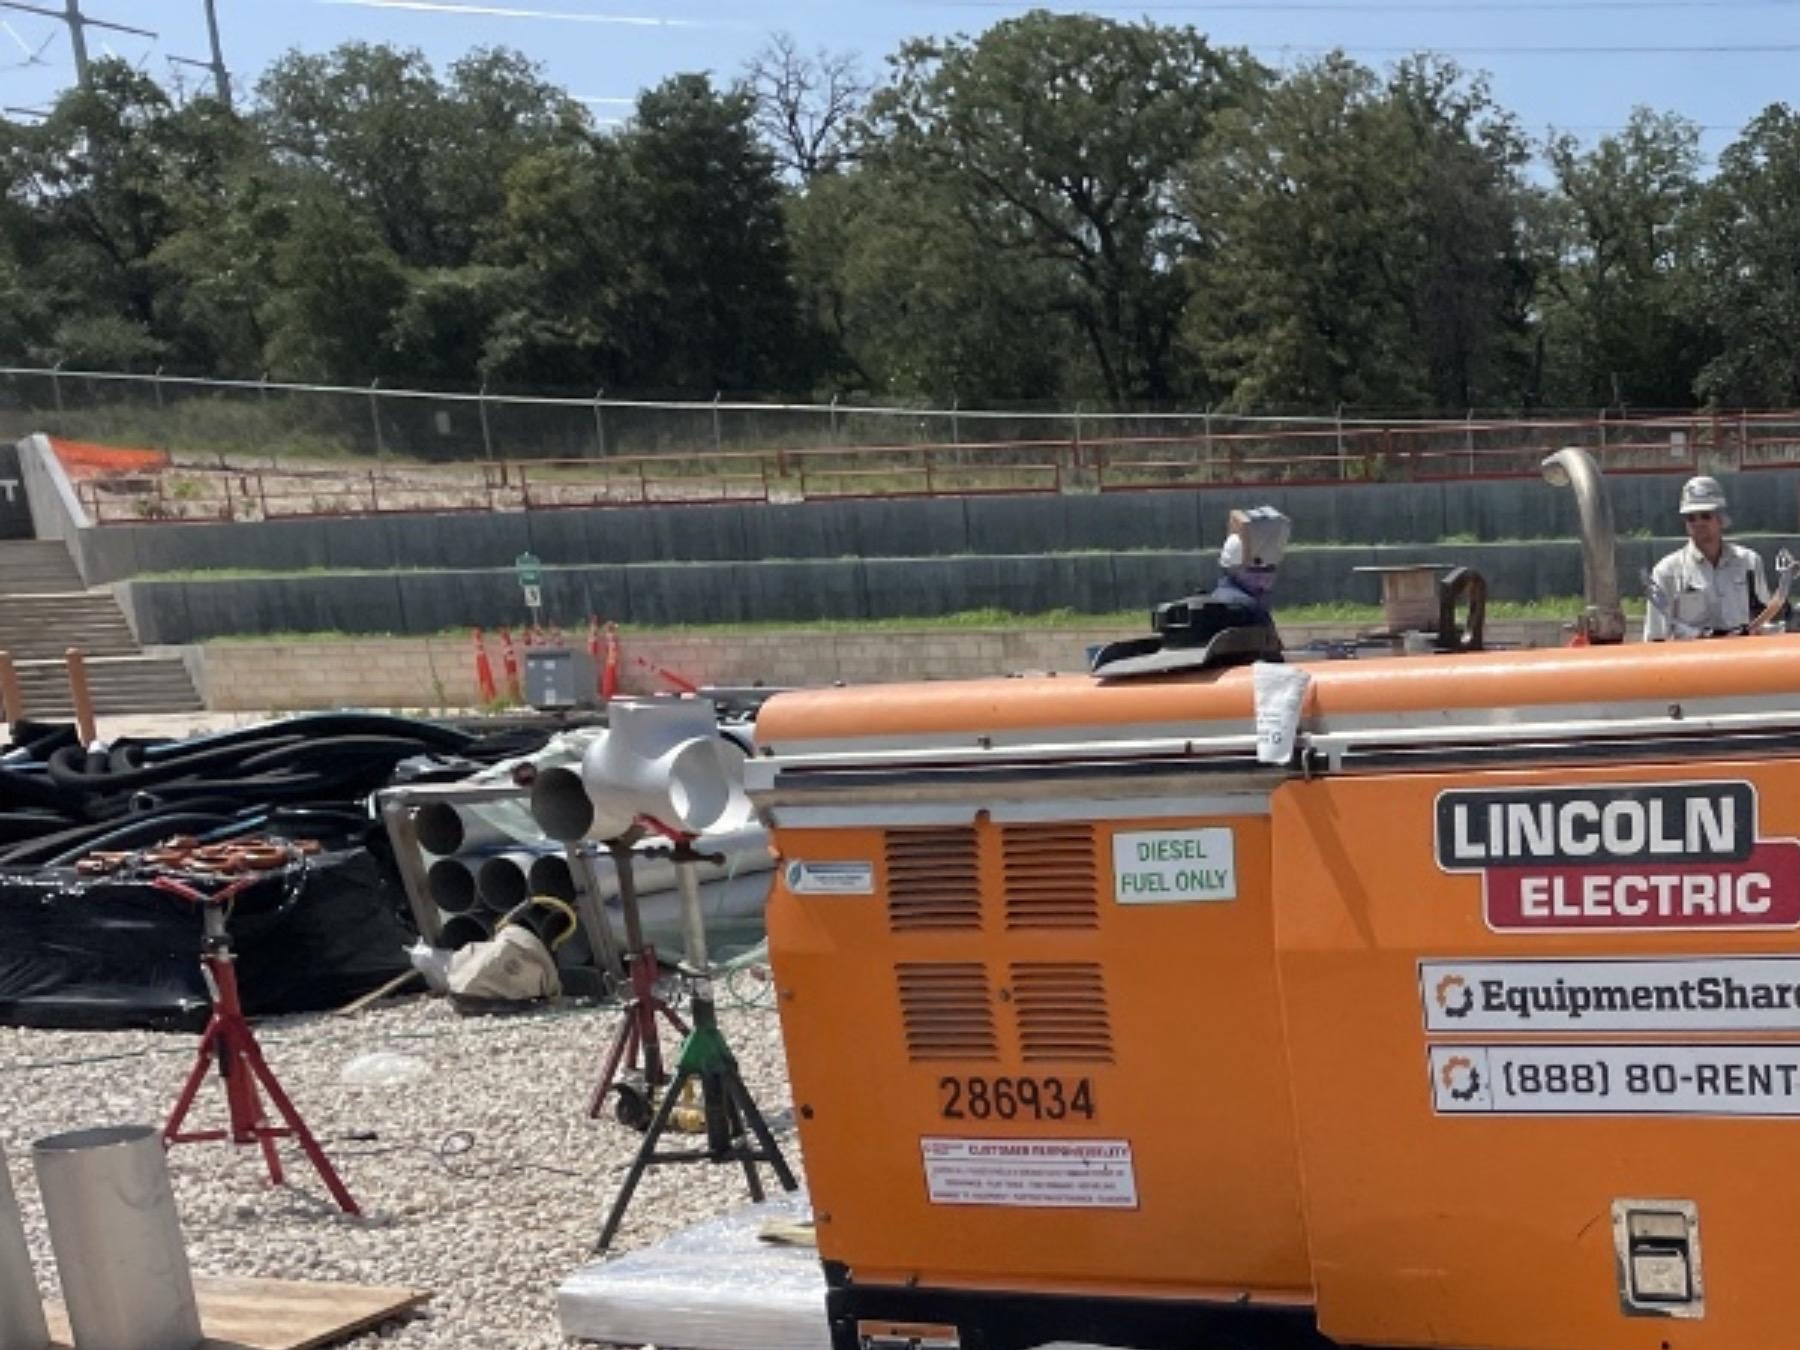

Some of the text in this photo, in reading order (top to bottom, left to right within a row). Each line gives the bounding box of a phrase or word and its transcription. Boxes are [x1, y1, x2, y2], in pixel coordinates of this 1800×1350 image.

[1452, 795, 1737, 860] LINCOLN
[1136, 839, 1209, 862] DIESEL
[1120, 869, 1229, 896] FUEL ONLY
[1519, 871, 1772, 918] ELECTRIC
[938, 1075, 1096, 1121] 286934
[1502, 1061, 1610, 1097] (888)
